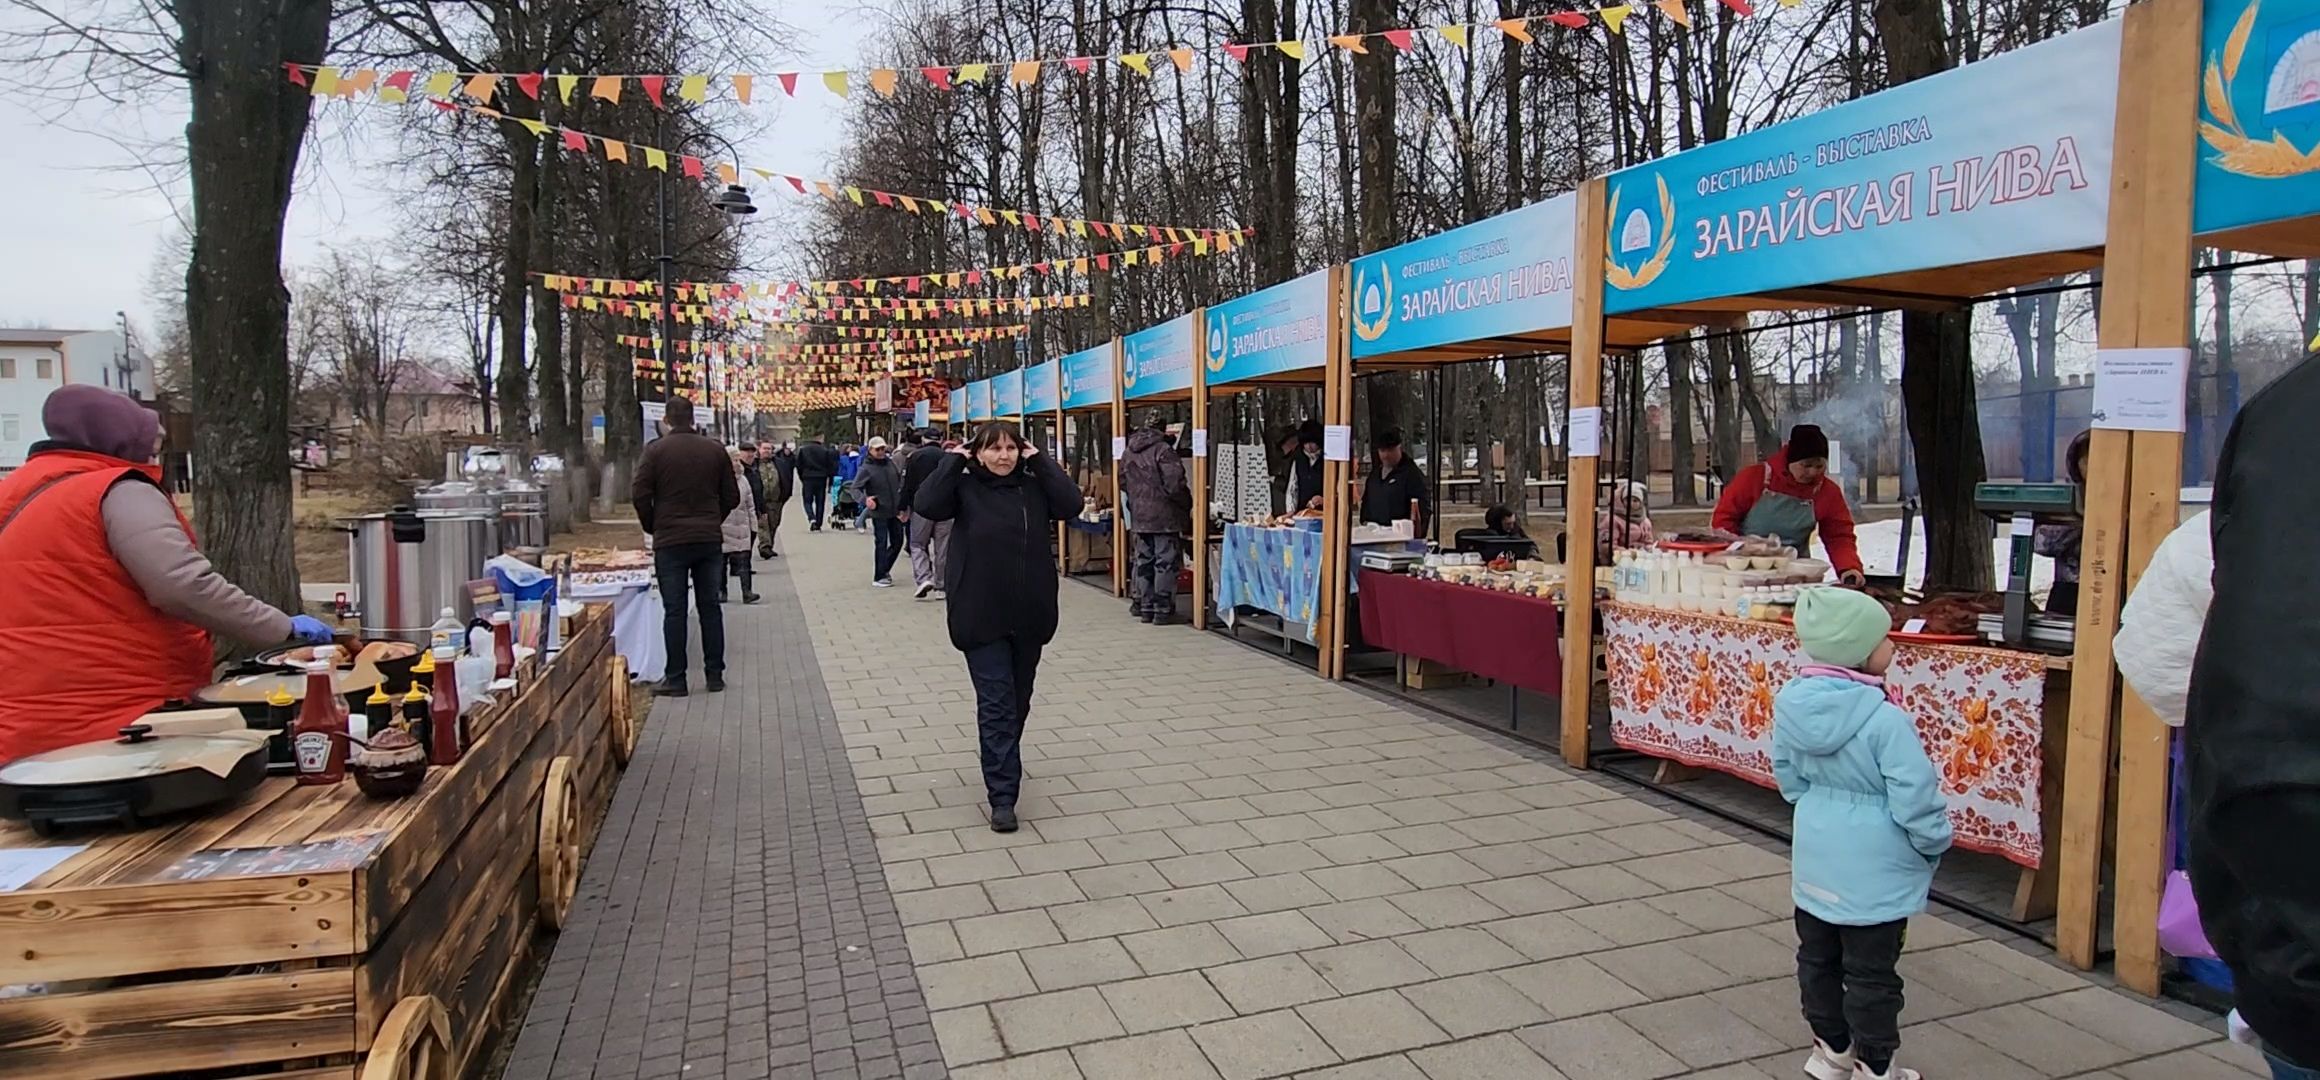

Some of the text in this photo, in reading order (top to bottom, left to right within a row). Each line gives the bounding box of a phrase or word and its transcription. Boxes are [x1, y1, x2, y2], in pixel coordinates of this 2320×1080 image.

[1696, 152, 1798, 196] ФЕСТИВАЛЬ
[1815, 115, 1933, 167] ВЫСТАВКА
[1693, 135, 2088, 260] ЗАРАЙСКАЯ НИВА
[1401, 256, 1573, 322] ЗАРАЙСКАЯ НИВА
